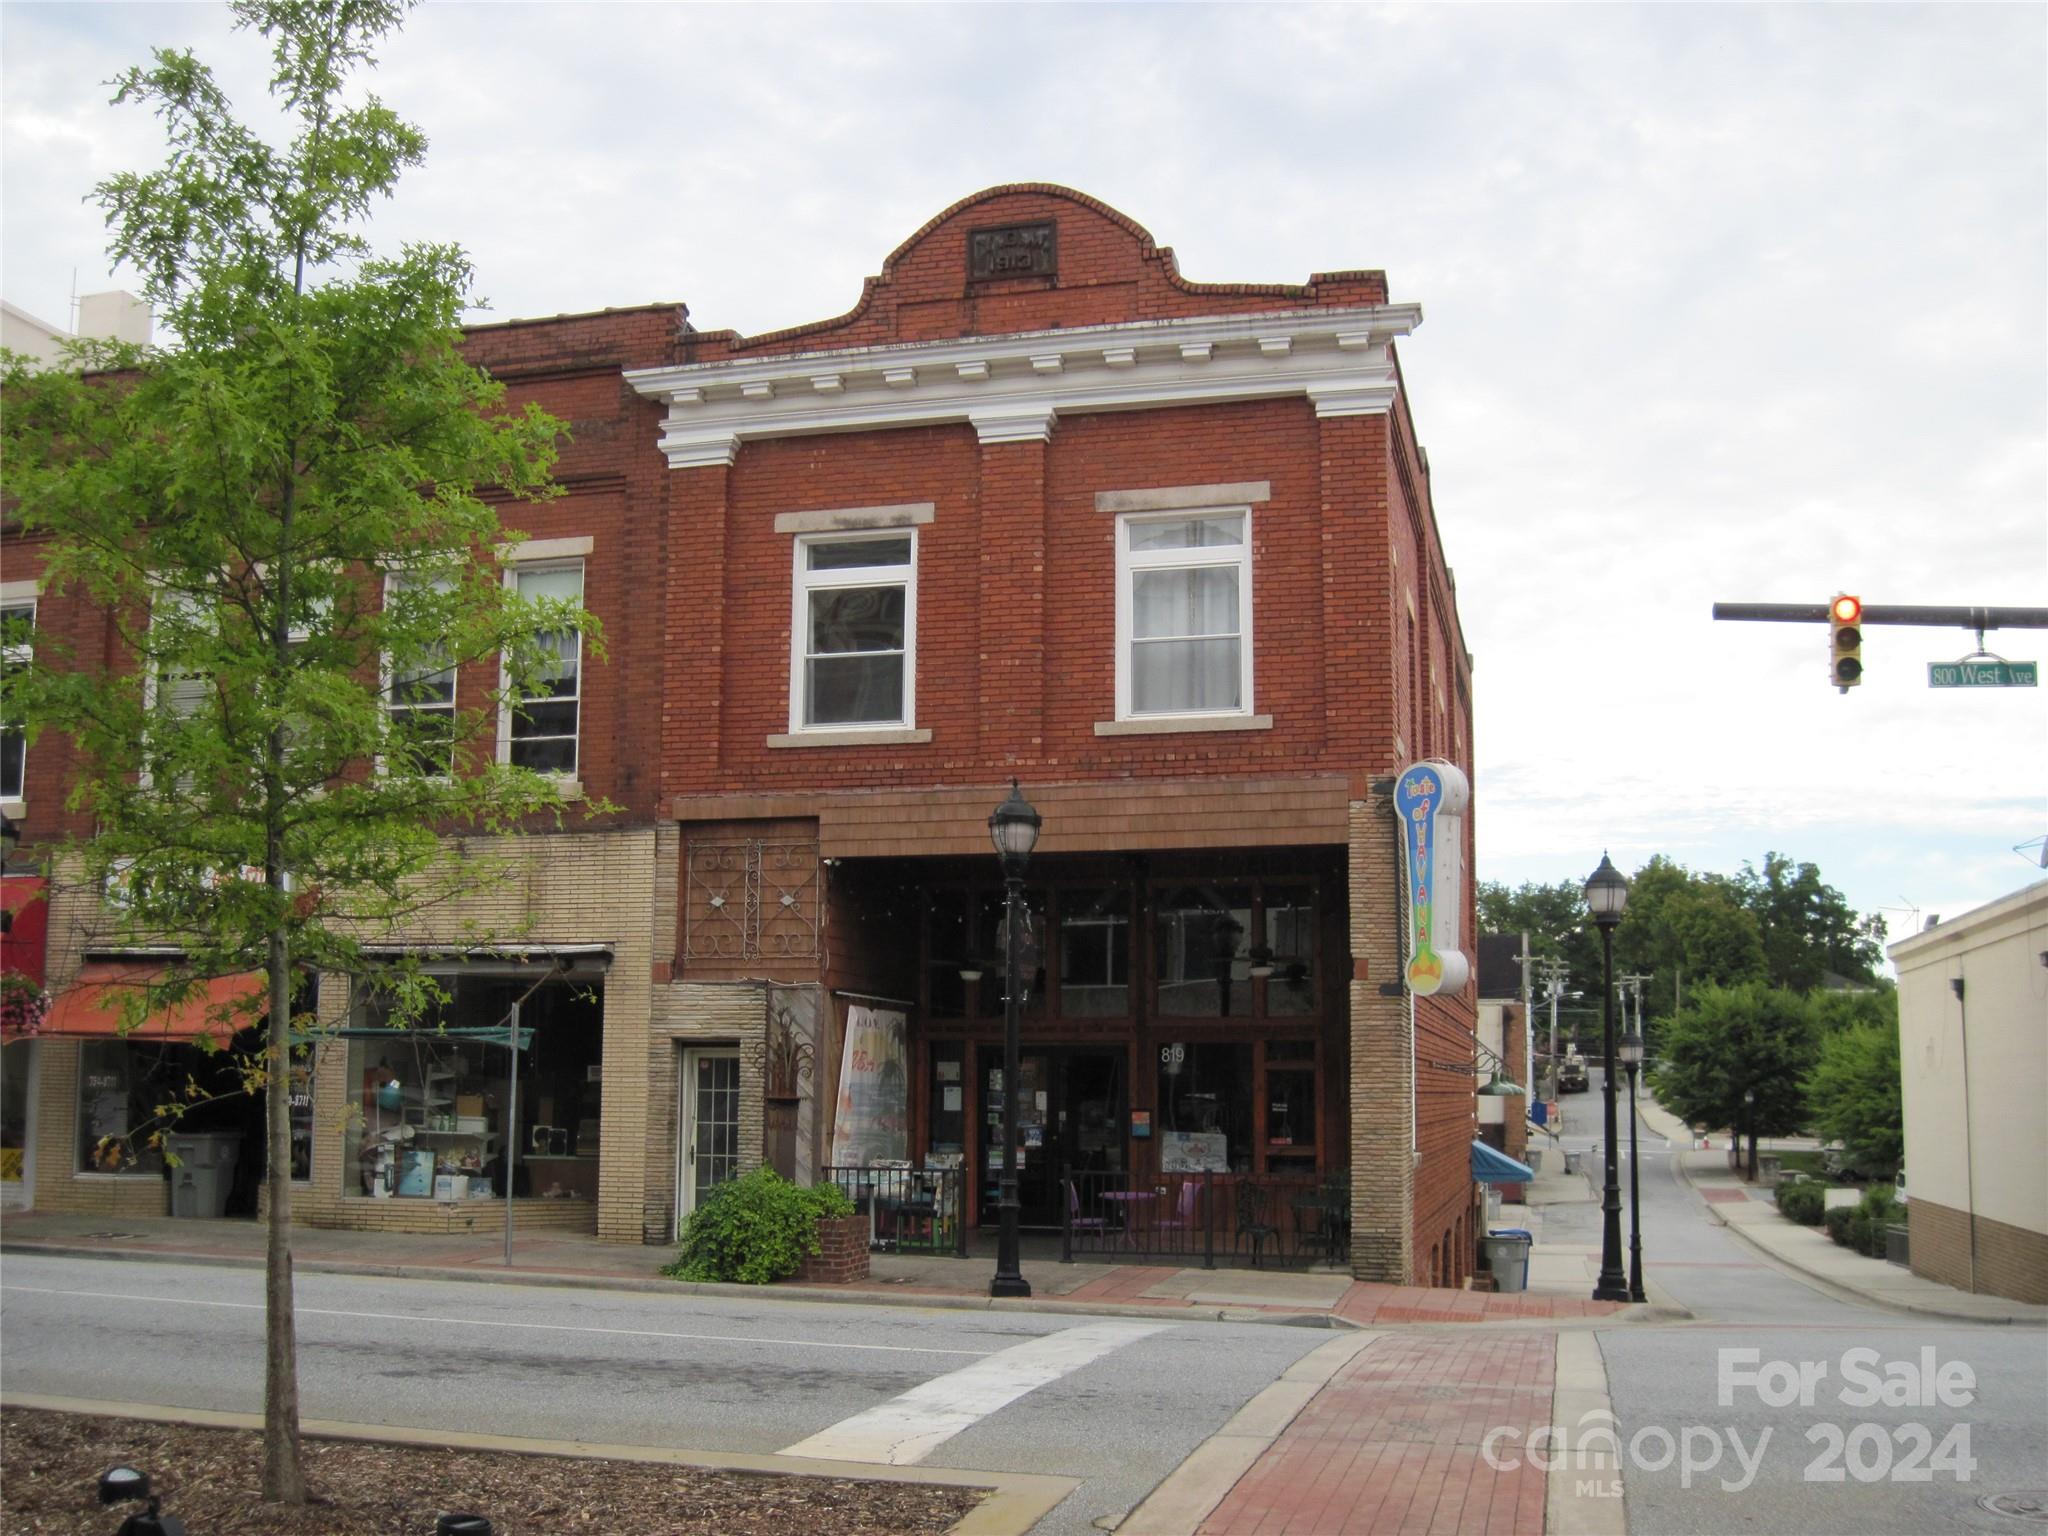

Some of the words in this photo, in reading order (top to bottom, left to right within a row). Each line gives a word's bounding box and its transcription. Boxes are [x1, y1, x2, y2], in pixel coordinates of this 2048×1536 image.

[1933, 667, 1956, 685] 800
[1959, 664, 2001, 685] West
[1412, 798, 1430, 821] of
[1415, 822, 1428, 945] HAVANA
[1161, 1047, 1185, 1063] 819
